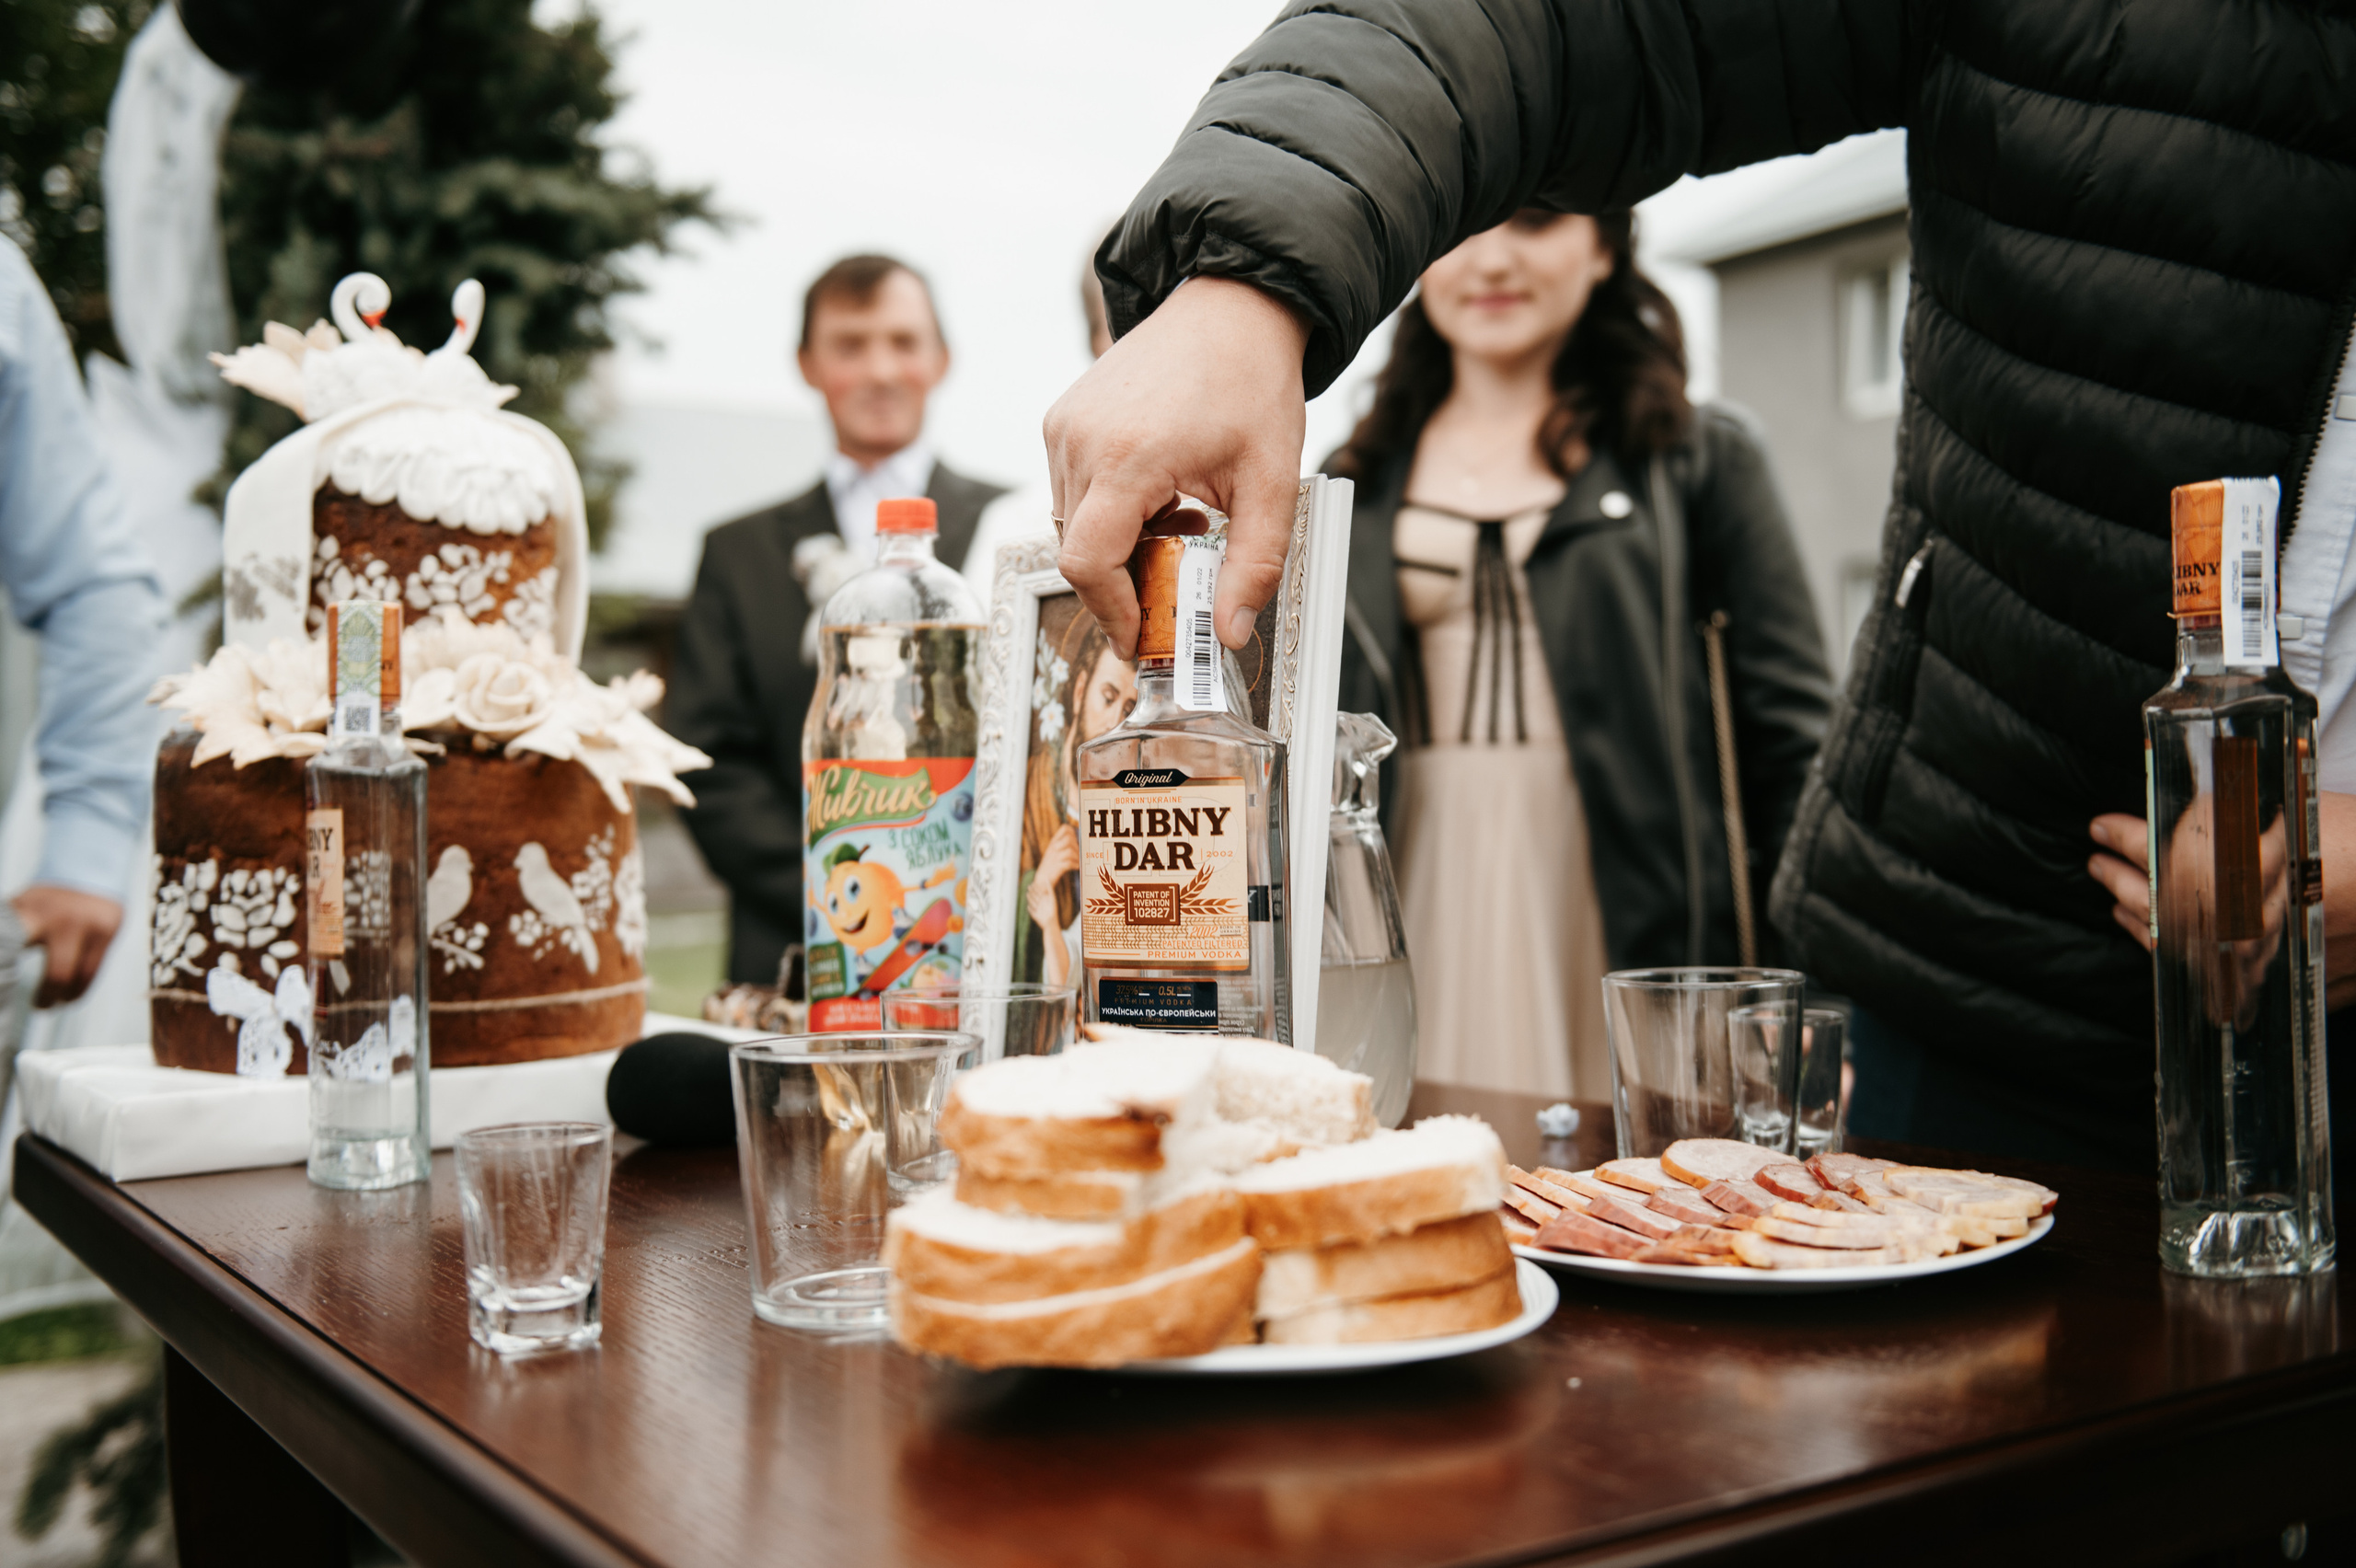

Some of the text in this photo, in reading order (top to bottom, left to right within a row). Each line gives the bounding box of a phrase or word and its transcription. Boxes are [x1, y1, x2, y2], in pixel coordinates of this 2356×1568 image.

[1195, 592, 1202, 600] 26
[1184, 617, 1193, 658] 0042735405
[1124, 771, 1172, 788] Original
[1147, 796, 1183, 804] UKRAINE
[1088, 807, 1231, 837] HLIBNY
[1114, 842, 1196, 870] DAR
[1133, 891, 1170, 899] PATENT OF
[1134, 907, 1170, 918] 102827
[1190, 926, 1218, 938] 2002
[1162, 940, 1242, 949] PATENTED FILTERED
[1148, 951, 1242, 959] PREMIUM VODKA
[1158, 986, 1176, 997] 0.5L
[1102, 1007, 1144, 1017] УКРАЇНСЬКА
[1145, 1009, 1217, 1018] ПО-ЄВРОПЕЙСЬКИ
